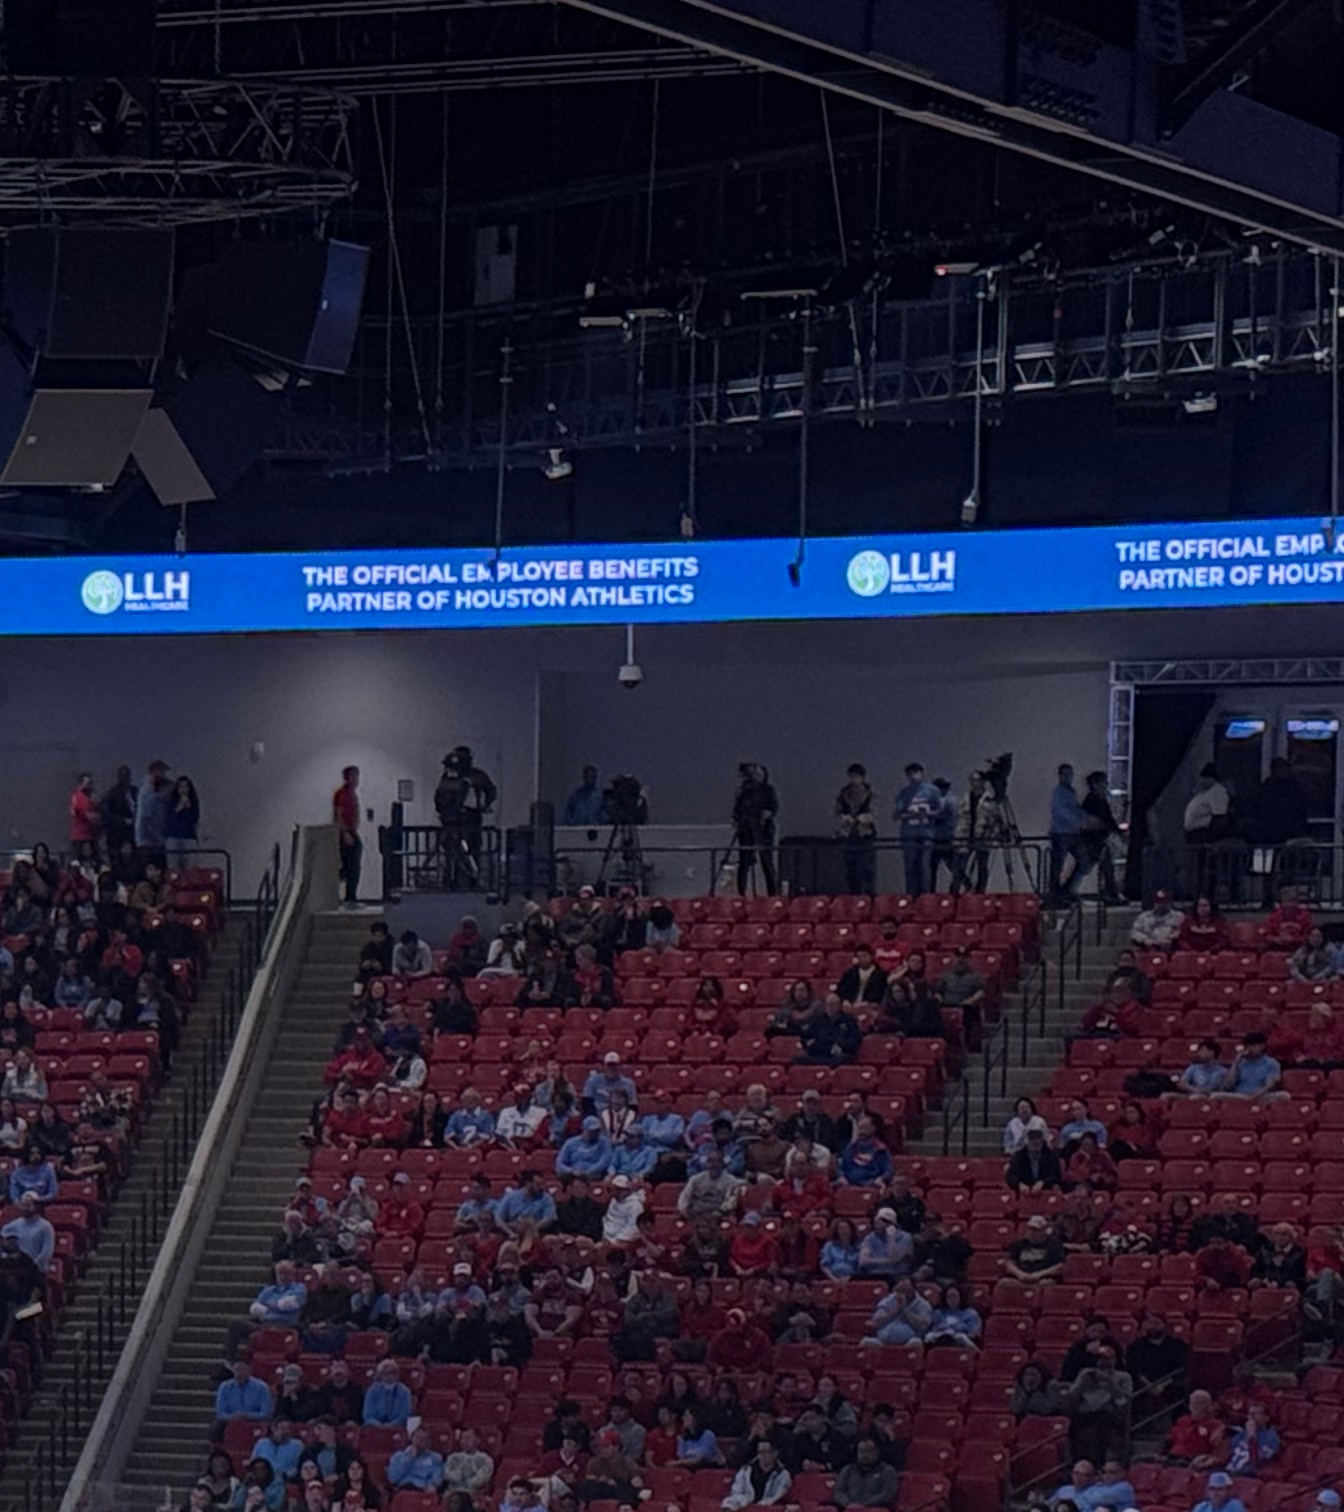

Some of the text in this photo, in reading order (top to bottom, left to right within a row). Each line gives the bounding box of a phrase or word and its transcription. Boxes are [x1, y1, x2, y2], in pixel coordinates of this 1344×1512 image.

[1116, 536, 1271, 562] THE OFFICIAL
[303, 565, 348, 587] THE
[352, 563, 458, 586] OFFICIAL
[588, 557, 699, 580] BENEFITS
[890, 551, 956, 580] LLH
[1119, 566, 1225, 590] PARTNER
[1229, 564, 1264, 586] OF
[125, 571, 189, 600] LLH
[307, 582, 695, 612] PARTNER OF HOUSTON ATHLETICS
